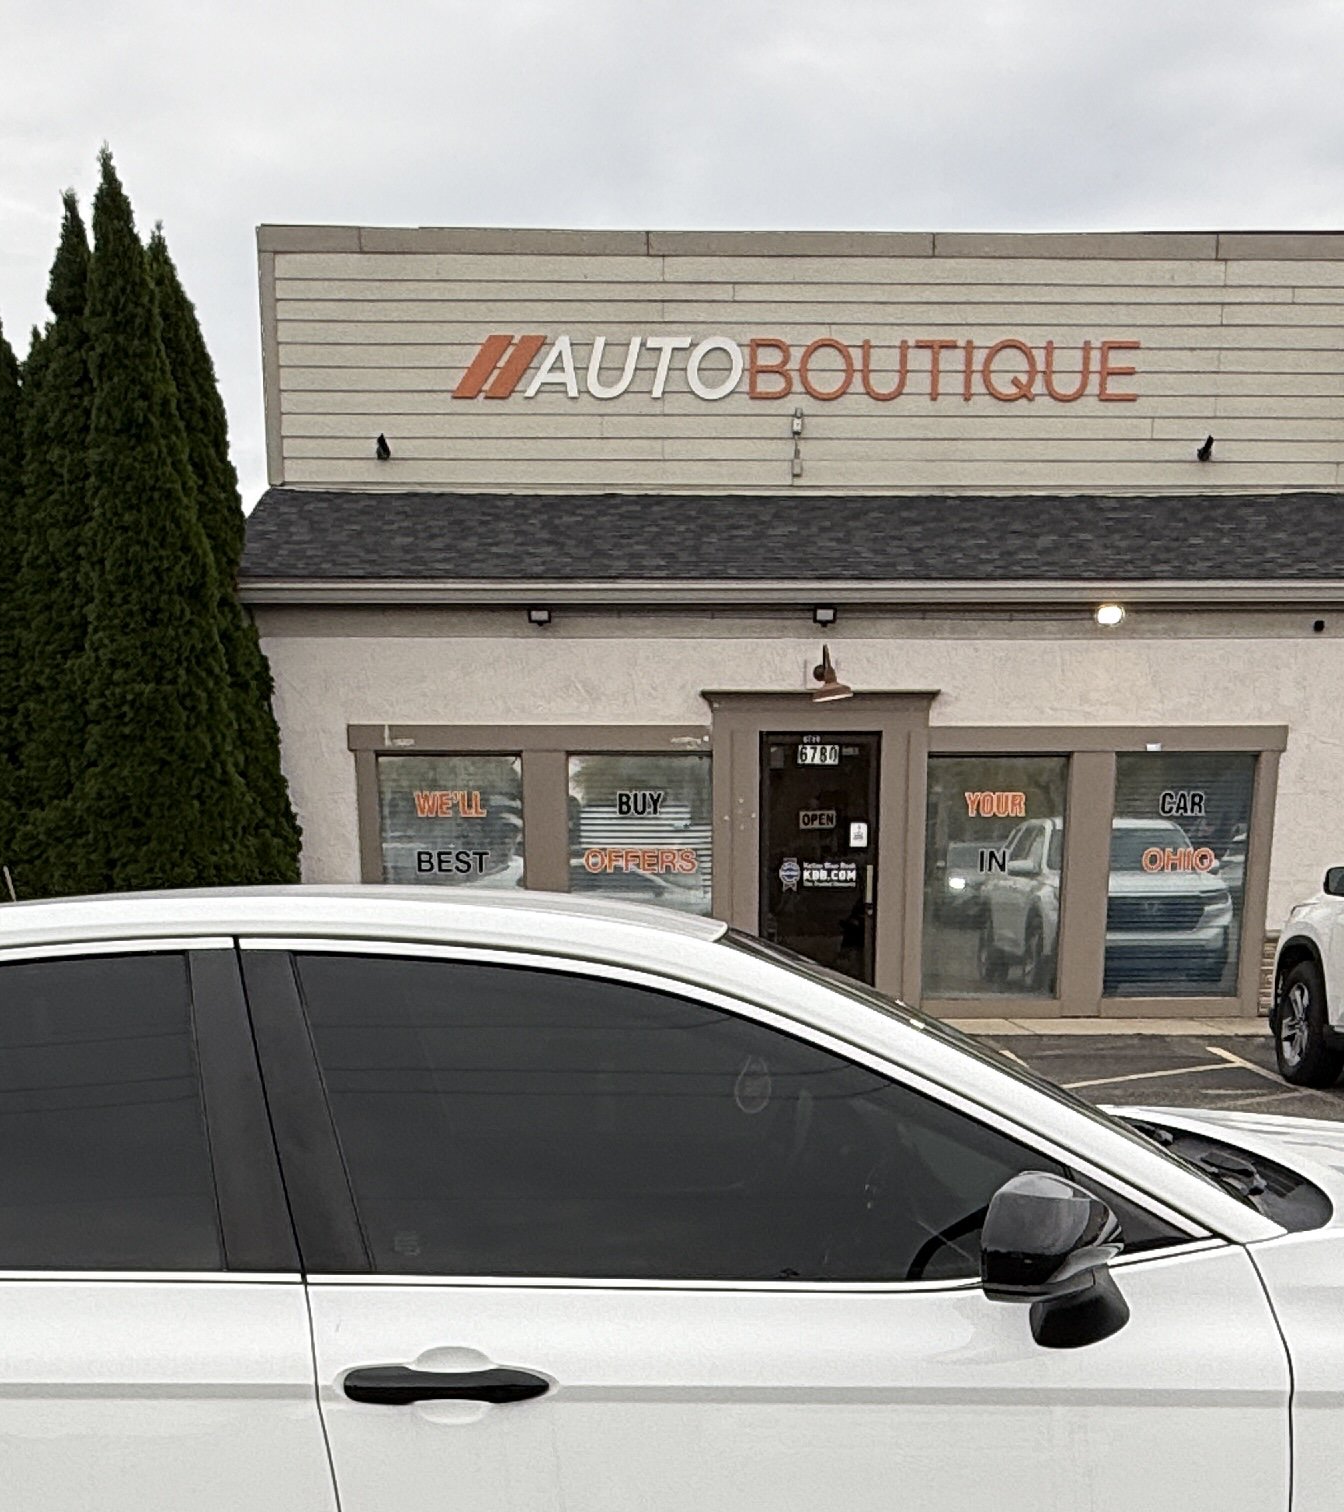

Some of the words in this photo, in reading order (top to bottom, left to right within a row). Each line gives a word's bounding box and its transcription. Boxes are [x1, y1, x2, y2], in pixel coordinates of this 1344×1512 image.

[524, 335, 1141, 402] AUTOBOUTIQUE
[799, 746, 838, 763] 6780
[414, 791, 487, 817] WE'LL
[617, 791, 665, 816] BUY
[965, 791, 1026, 818] YOUR
[1159, 791, 1205, 816] CAR
[802, 812, 835, 827] OPEN
[416, 850, 491, 875] BEST
[583, 848, 699, 874] OFFERS
[978, 849, 1007, 873] IN
[1142, 848, 1216, 873] OHIO
